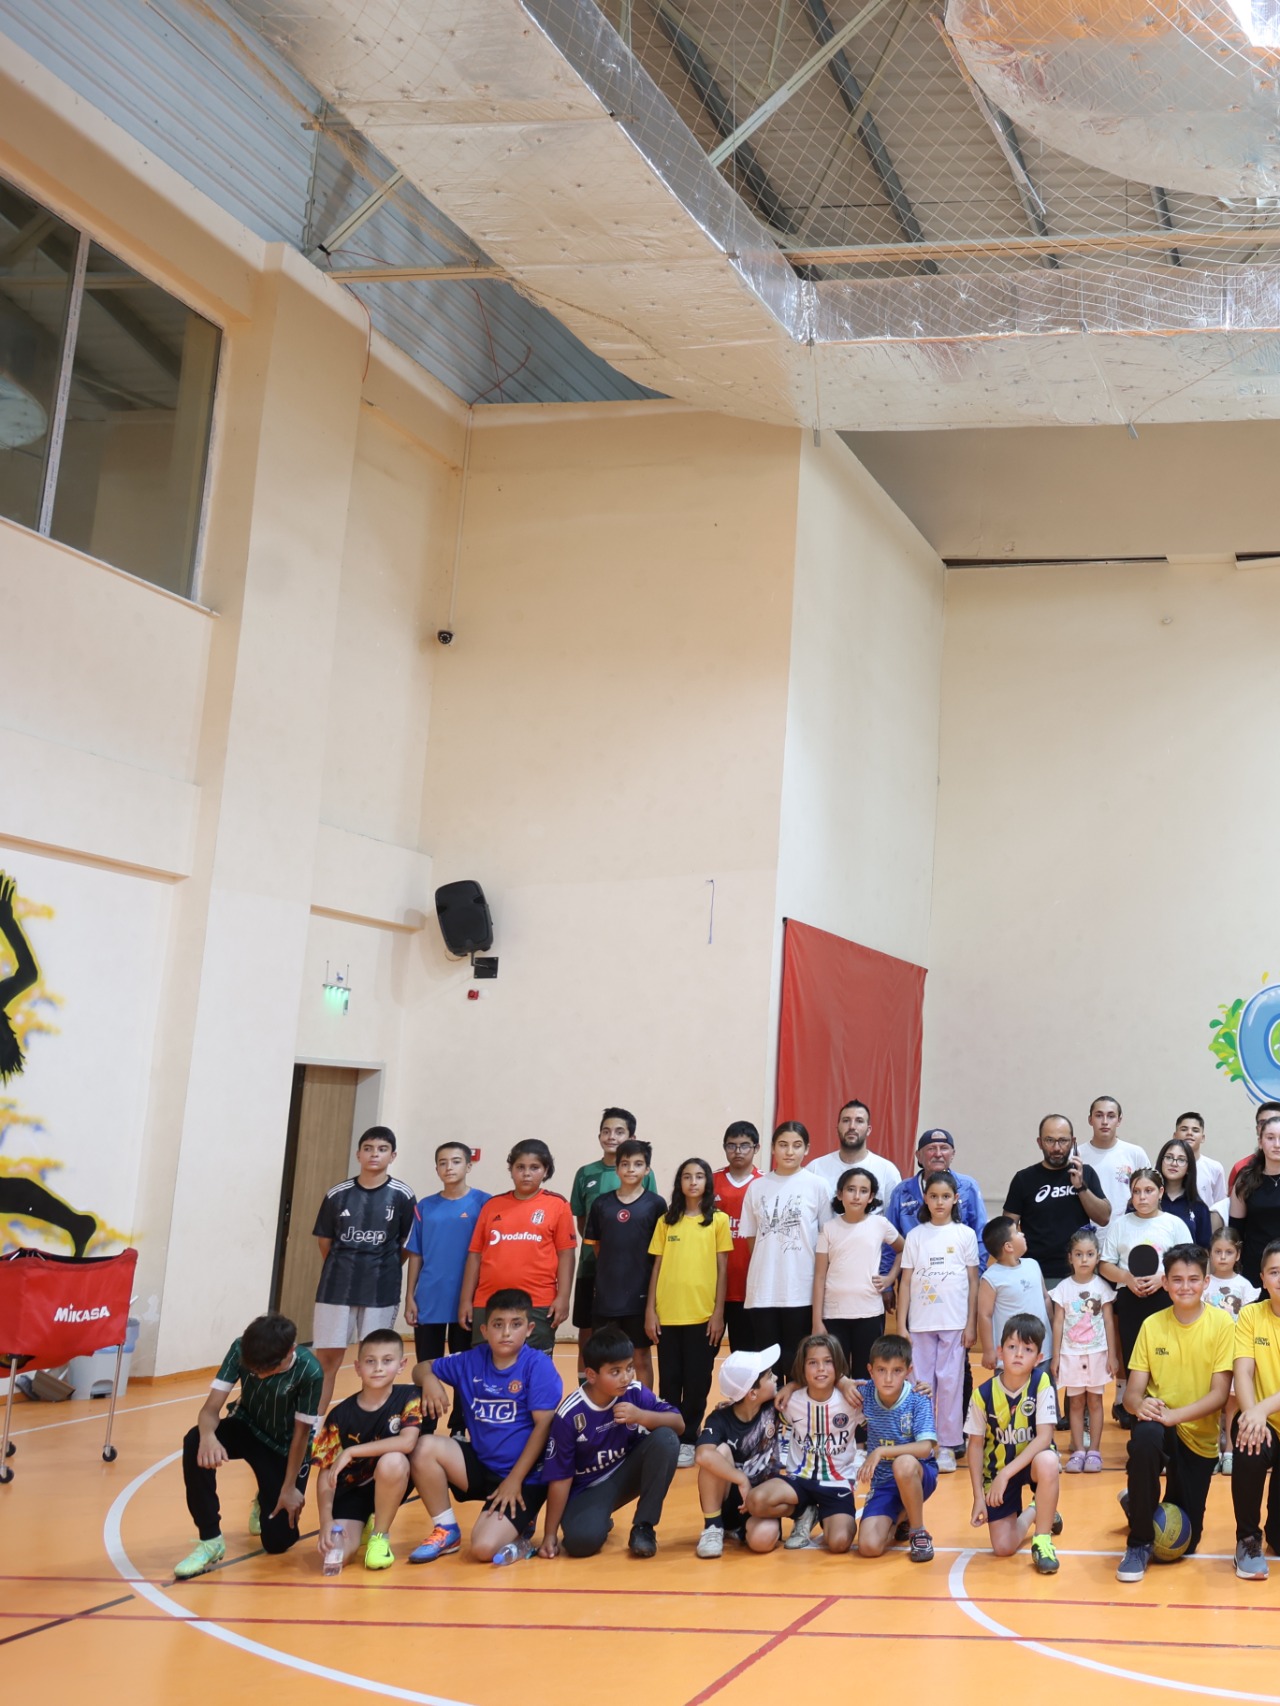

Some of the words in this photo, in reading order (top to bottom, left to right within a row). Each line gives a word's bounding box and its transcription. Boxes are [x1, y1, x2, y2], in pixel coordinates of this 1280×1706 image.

[1051, 1185, 1077, 1198] asic
[340, 1226, 387, 1246] Jeep
[501, 1231, 542, 1242] vodafone
[475, 1404, 512, 1420] AIG
